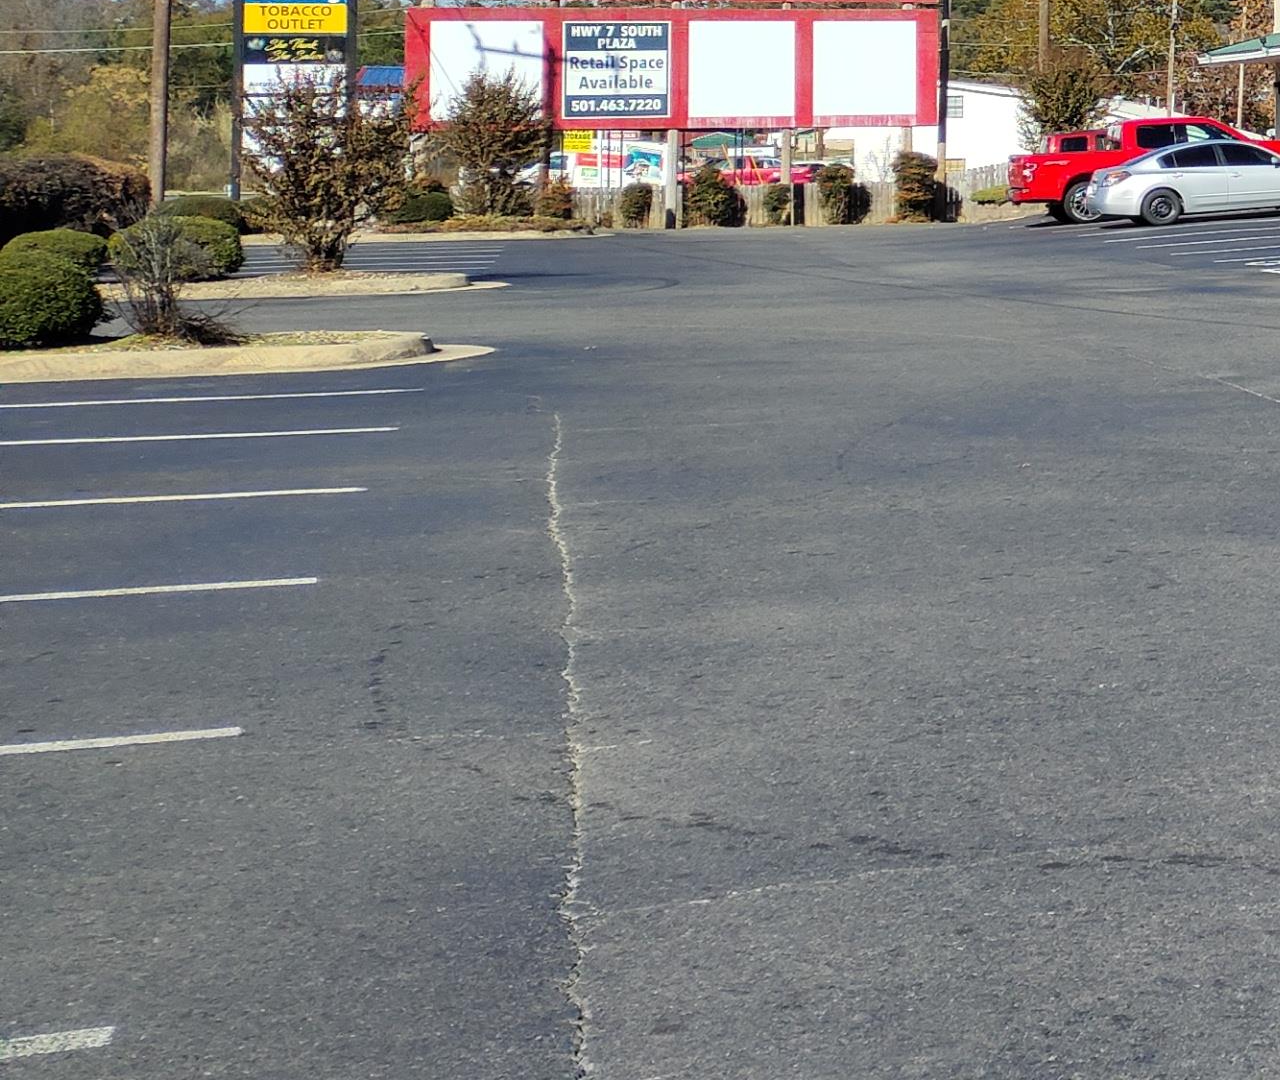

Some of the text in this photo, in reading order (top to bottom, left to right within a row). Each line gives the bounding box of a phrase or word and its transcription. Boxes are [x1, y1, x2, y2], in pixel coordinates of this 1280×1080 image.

[260, 6, 332, 16] TOBACCO
[267, 19, 325, 30] OUTLET
[571, 26, 662, 37] HWY 7 SOUTH
[597, 38, 637, 48] PLAZA
[570, 55, 664, 72] Retail Space
[579, 75, 653, 89] Available
[571, 99, 662, 112] 501.463.7220
